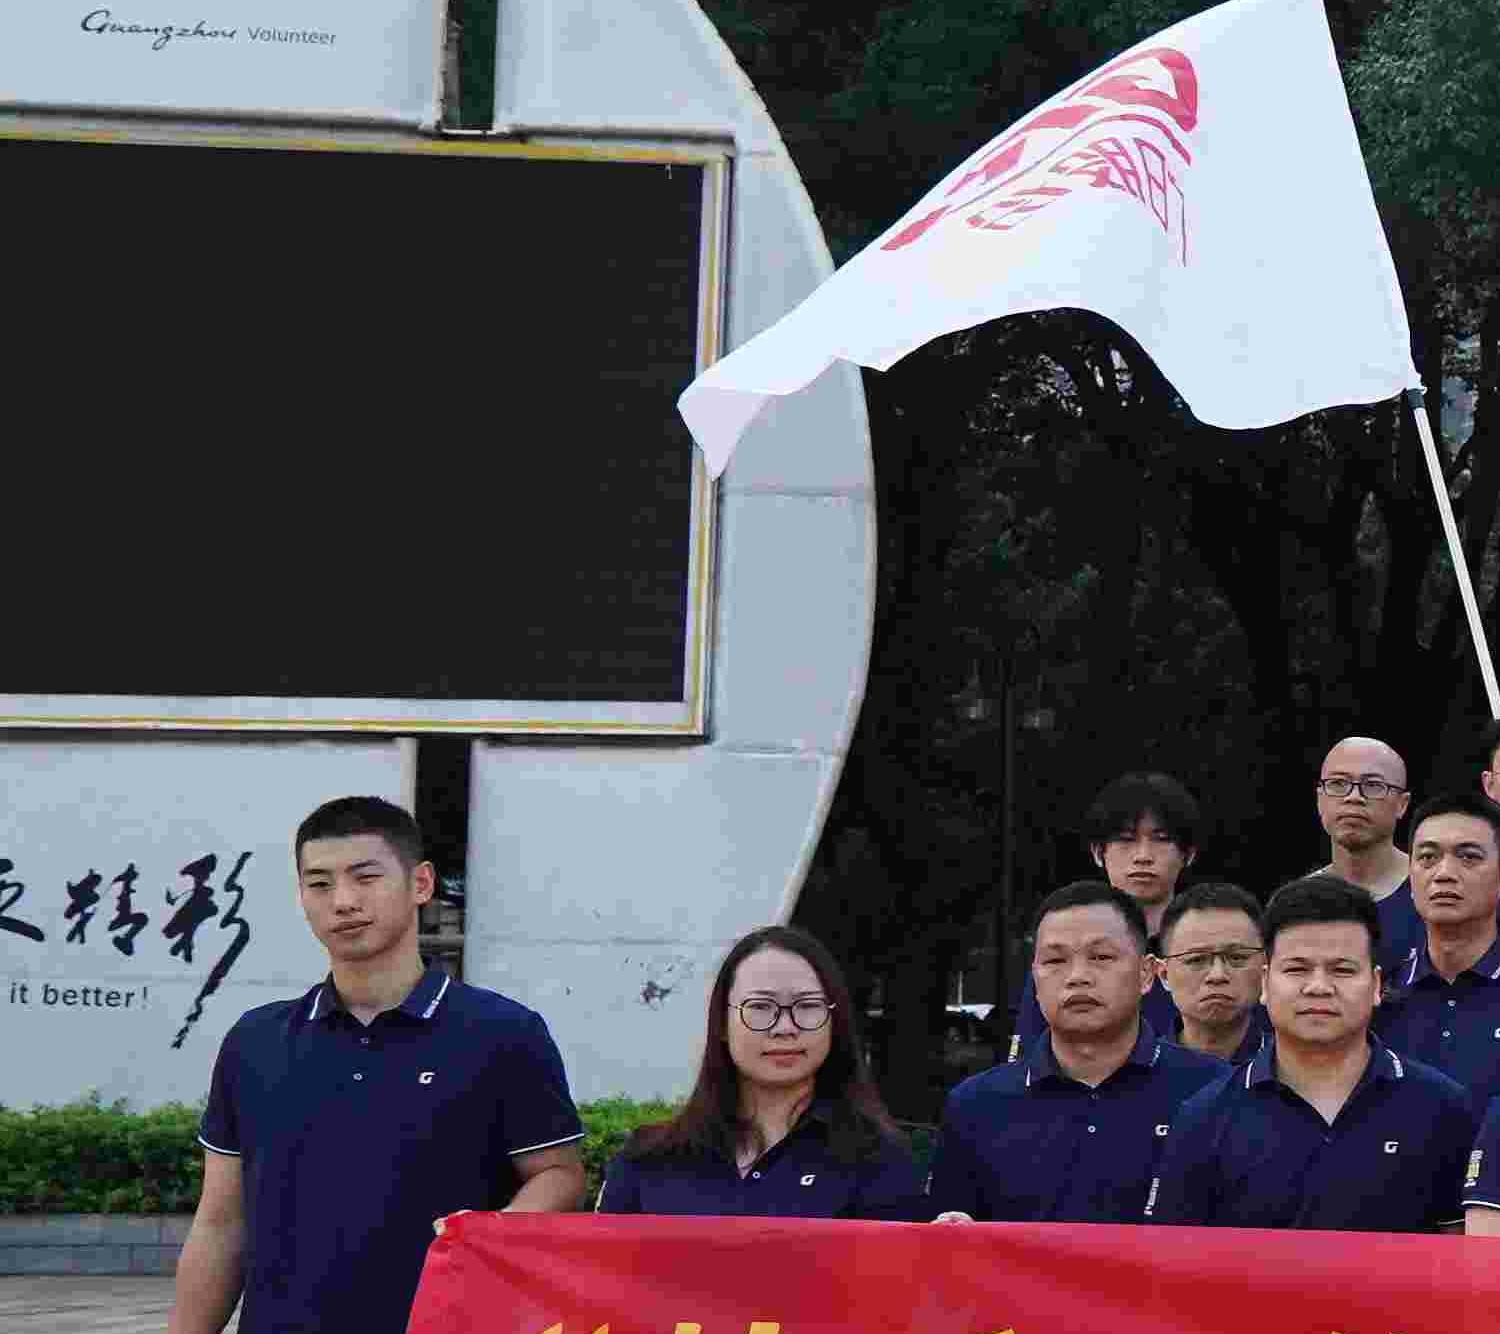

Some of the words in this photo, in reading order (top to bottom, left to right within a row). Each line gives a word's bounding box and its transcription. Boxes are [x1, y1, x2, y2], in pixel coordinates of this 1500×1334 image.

[247, 26, 336, 44] Volunteer
[10, 982, 29, 1005] it
[42, 982, 149, 1010] better!
